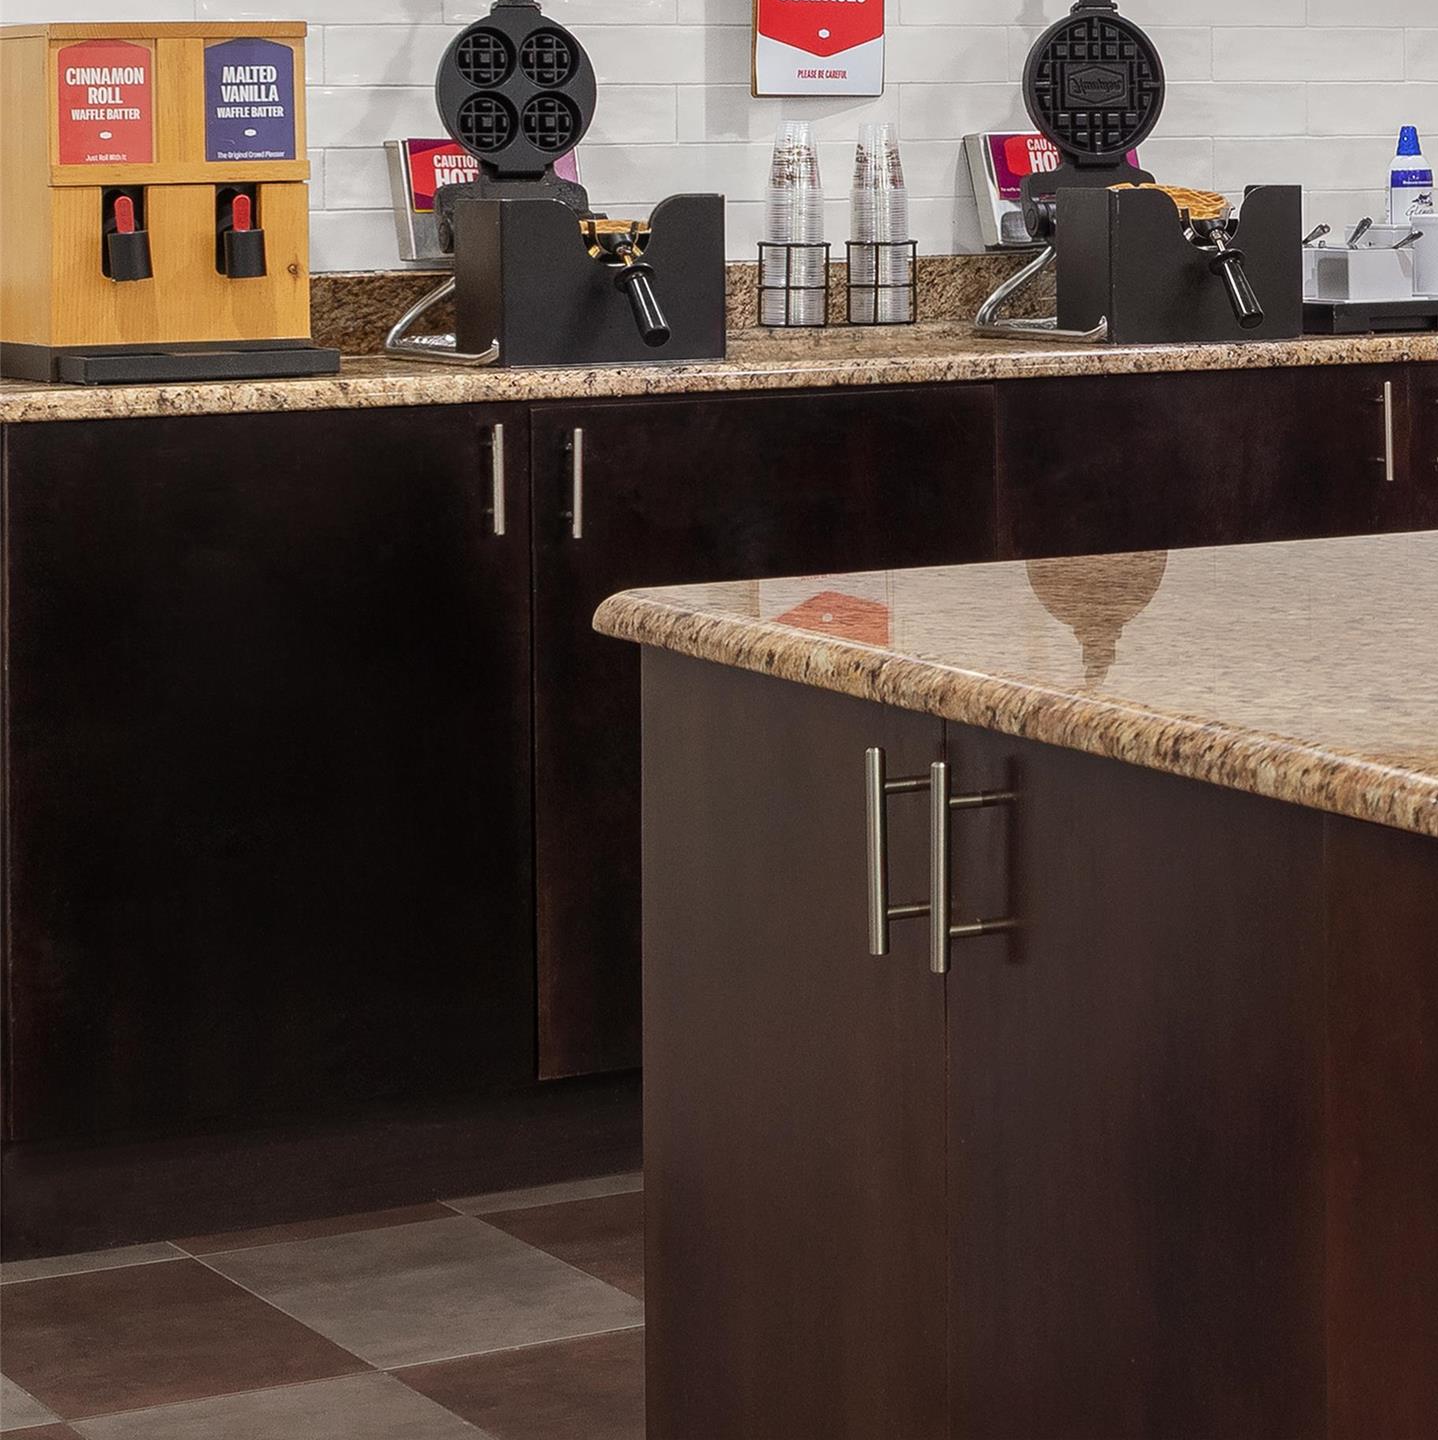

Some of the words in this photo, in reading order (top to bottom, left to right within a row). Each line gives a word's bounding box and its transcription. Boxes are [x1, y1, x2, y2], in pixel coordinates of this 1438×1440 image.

[65, 66, 145, 86] CINNAMON
[222, 65, 278, 84] MALTED
[797, 69, 817, 79] PLEASE
[817, 69, 825, 79] BE
[825, 69, 848, 80] CAREFUL
[87, 86, 123, 105] ROLL
[221, 84, 279, 103] VANILLA
[71, 108, 106, 121] WAFFLE
[106, 108, 141, 121] BATTER
[216, 106, 251, 119] WAFFLE
[251, 105, 285, 119] BATTER
